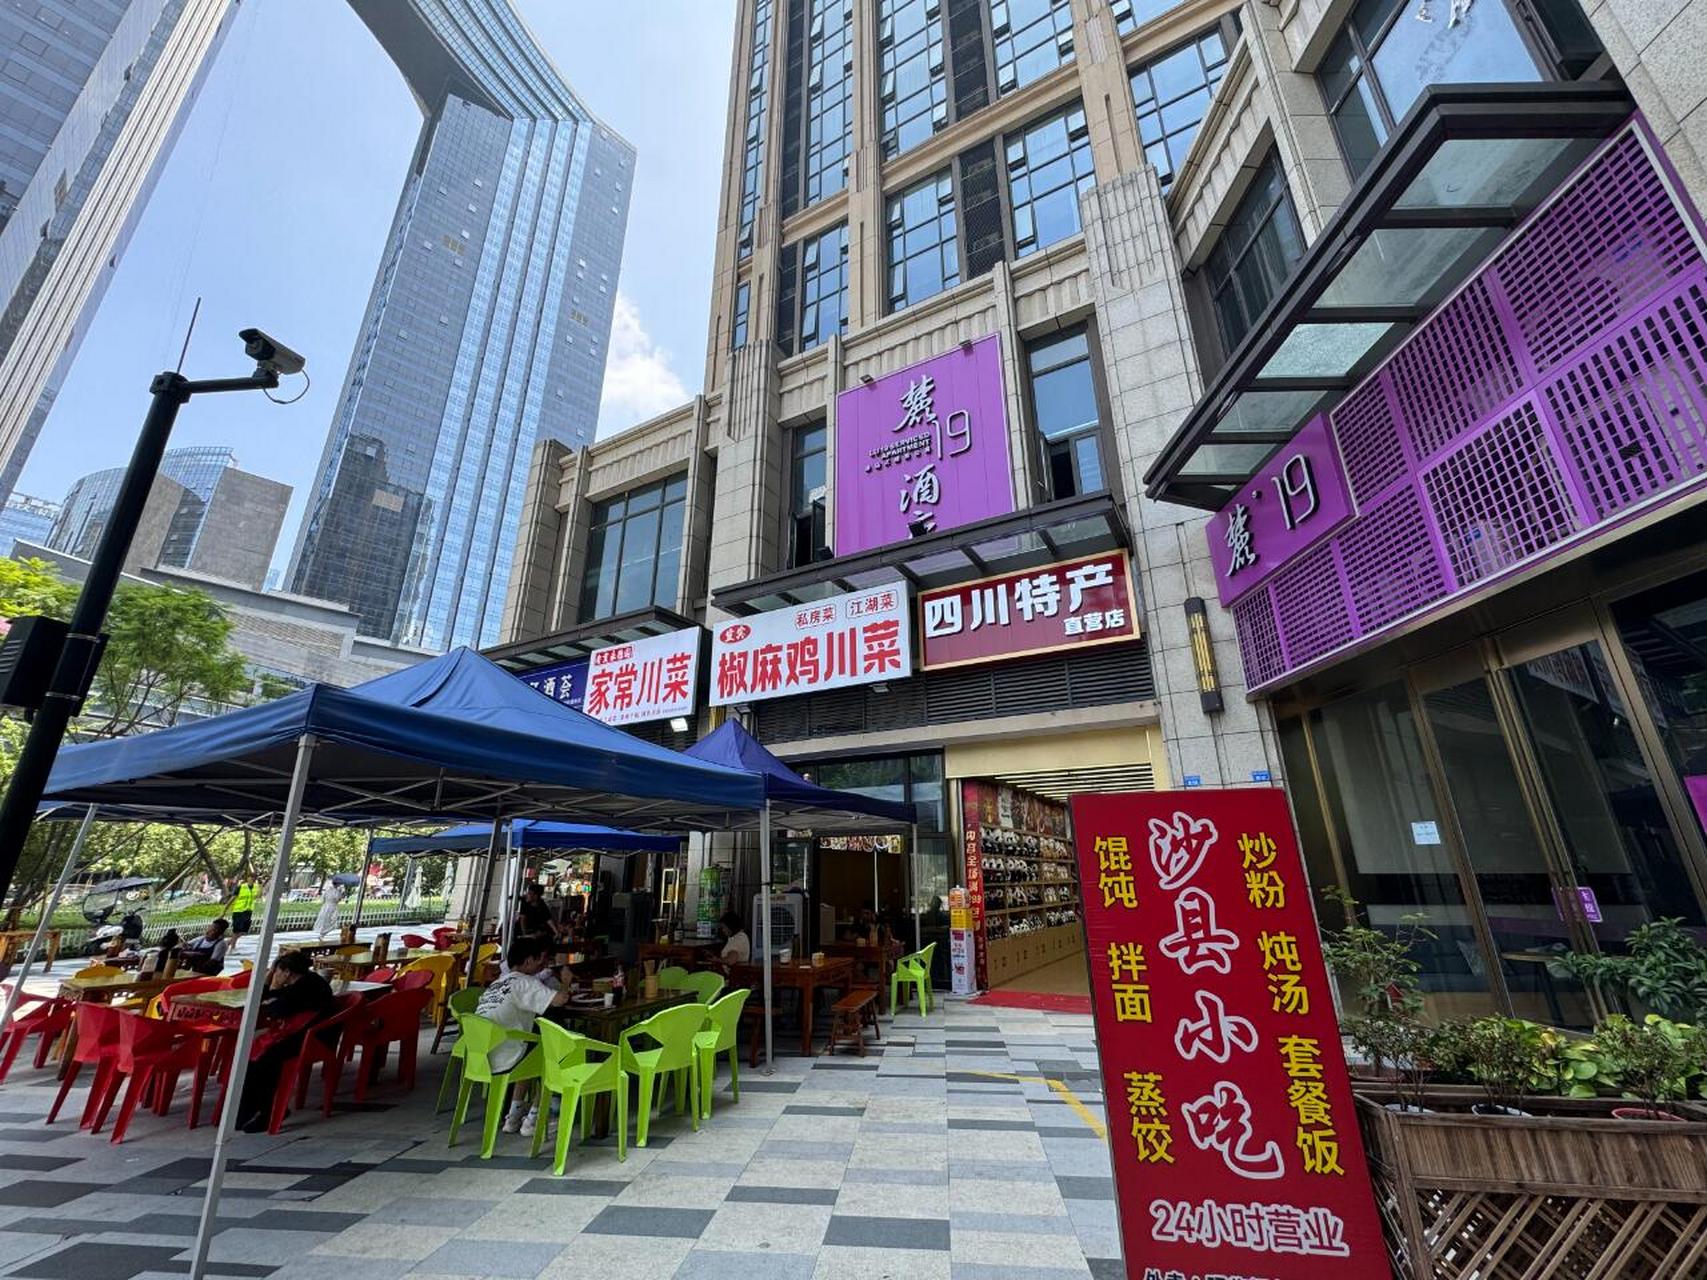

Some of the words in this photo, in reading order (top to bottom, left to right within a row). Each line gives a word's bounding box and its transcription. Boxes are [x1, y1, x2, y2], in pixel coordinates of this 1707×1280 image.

[932, 409, 971, 460] 19
[1271, 454, 1319, 530] 19
[796, 607, 835, 626] 私房菜
[850, 593, 894, 616] 江湖菜
[924, 563, 1113, 638] 四川特产
[1063, 609, 1125, 636] 直营店
[587, 651, 691, 715] 家常川菜
[717, 619, 901, 699] 椒麻鸡川菜
[1094, 836, 1138, 909] 馄饨
[1238, 832, 1286, 909] 炒粉
[1107, 941, 1153, 1024] 拌面
[1148, 811, 1287, 1180] 沙县小吃
[1257, 930, 1310, 1016] 炖汤
[1122, 1071, 1176, 1165] 蒸饺
[1277, 1034, 1345, 1176] 套餐饭
[1149, 1199, 1351, 1258] 24小时营业
